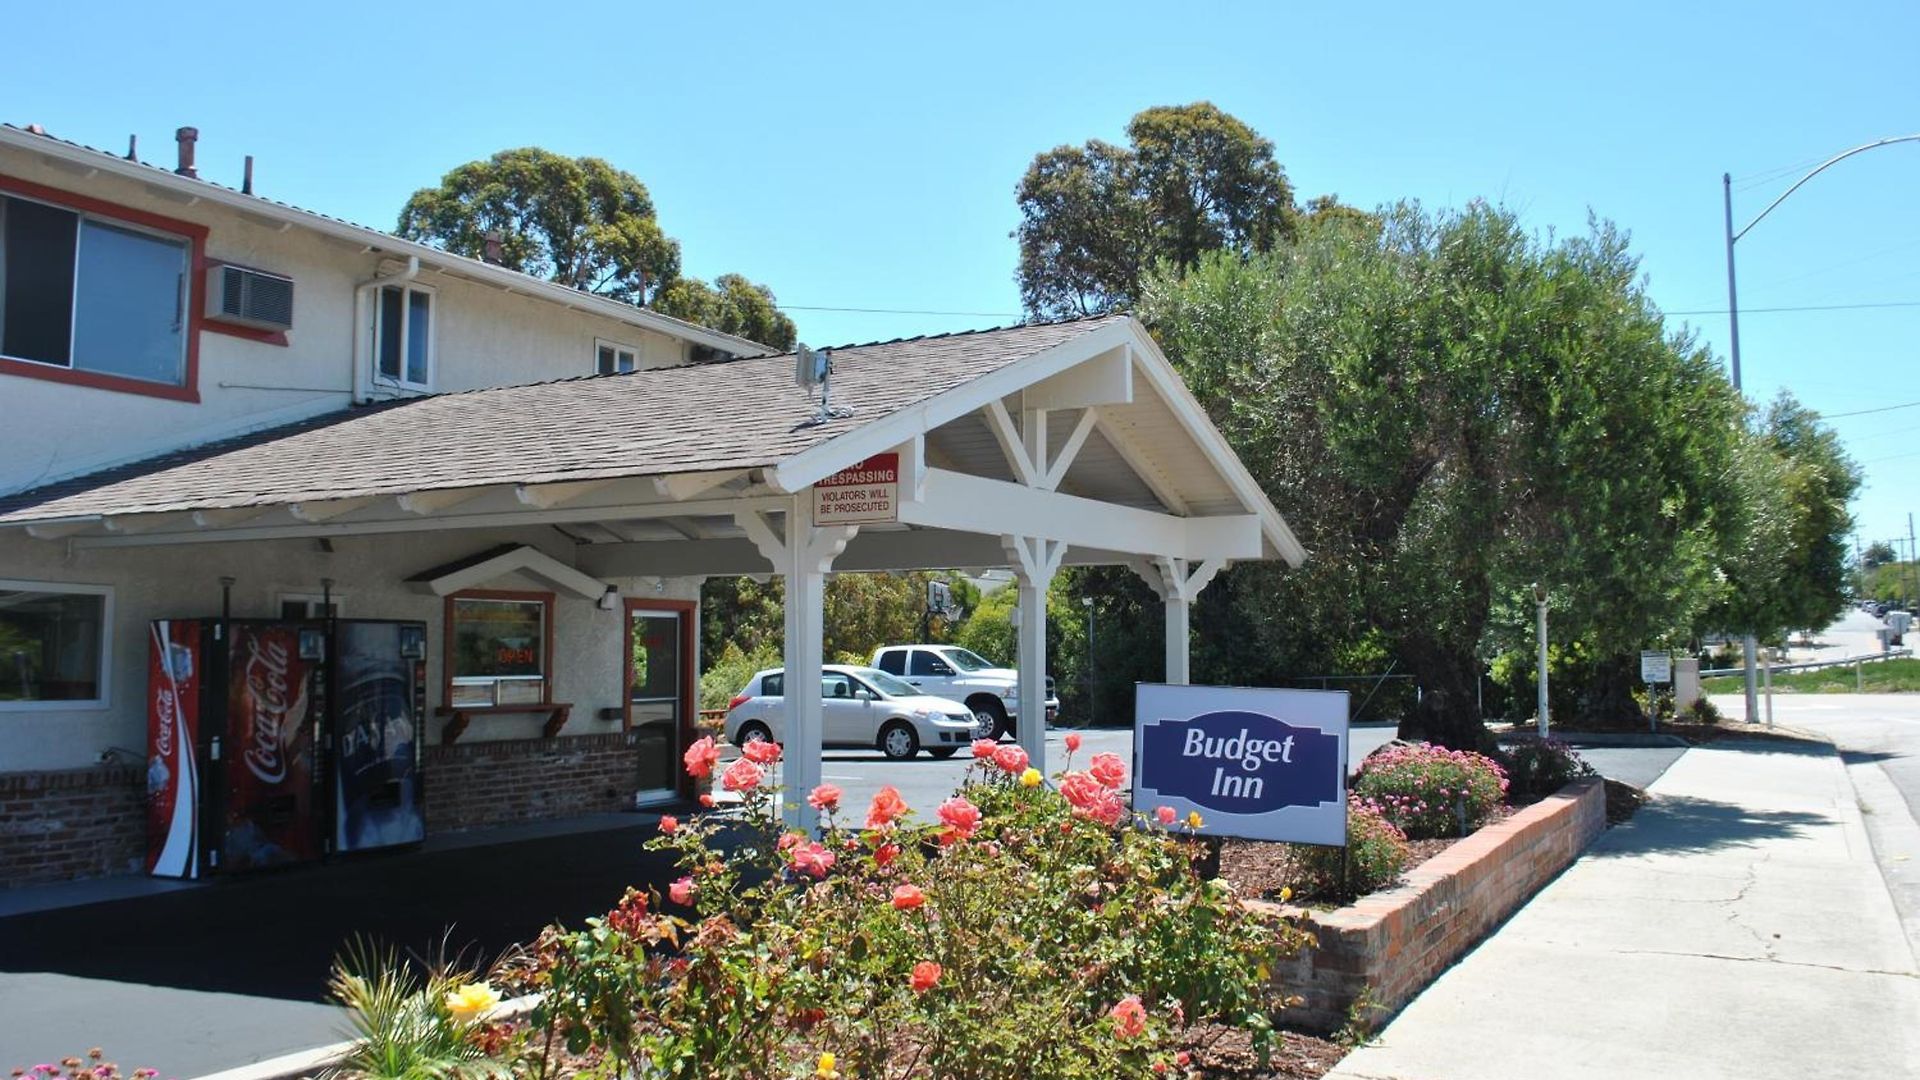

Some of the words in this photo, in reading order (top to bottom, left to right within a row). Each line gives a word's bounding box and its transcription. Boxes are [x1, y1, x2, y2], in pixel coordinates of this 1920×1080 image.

[821, 489, 866, 502] VIOLATORS
[869, 488, 889, 499] WILL
[820, 504, 832, 514] BE
[834, 500, 890, 513] PROSECUTED
[1182, 728, 1295, 771] Budget
[1211, 767, 1264, 799] Inn
